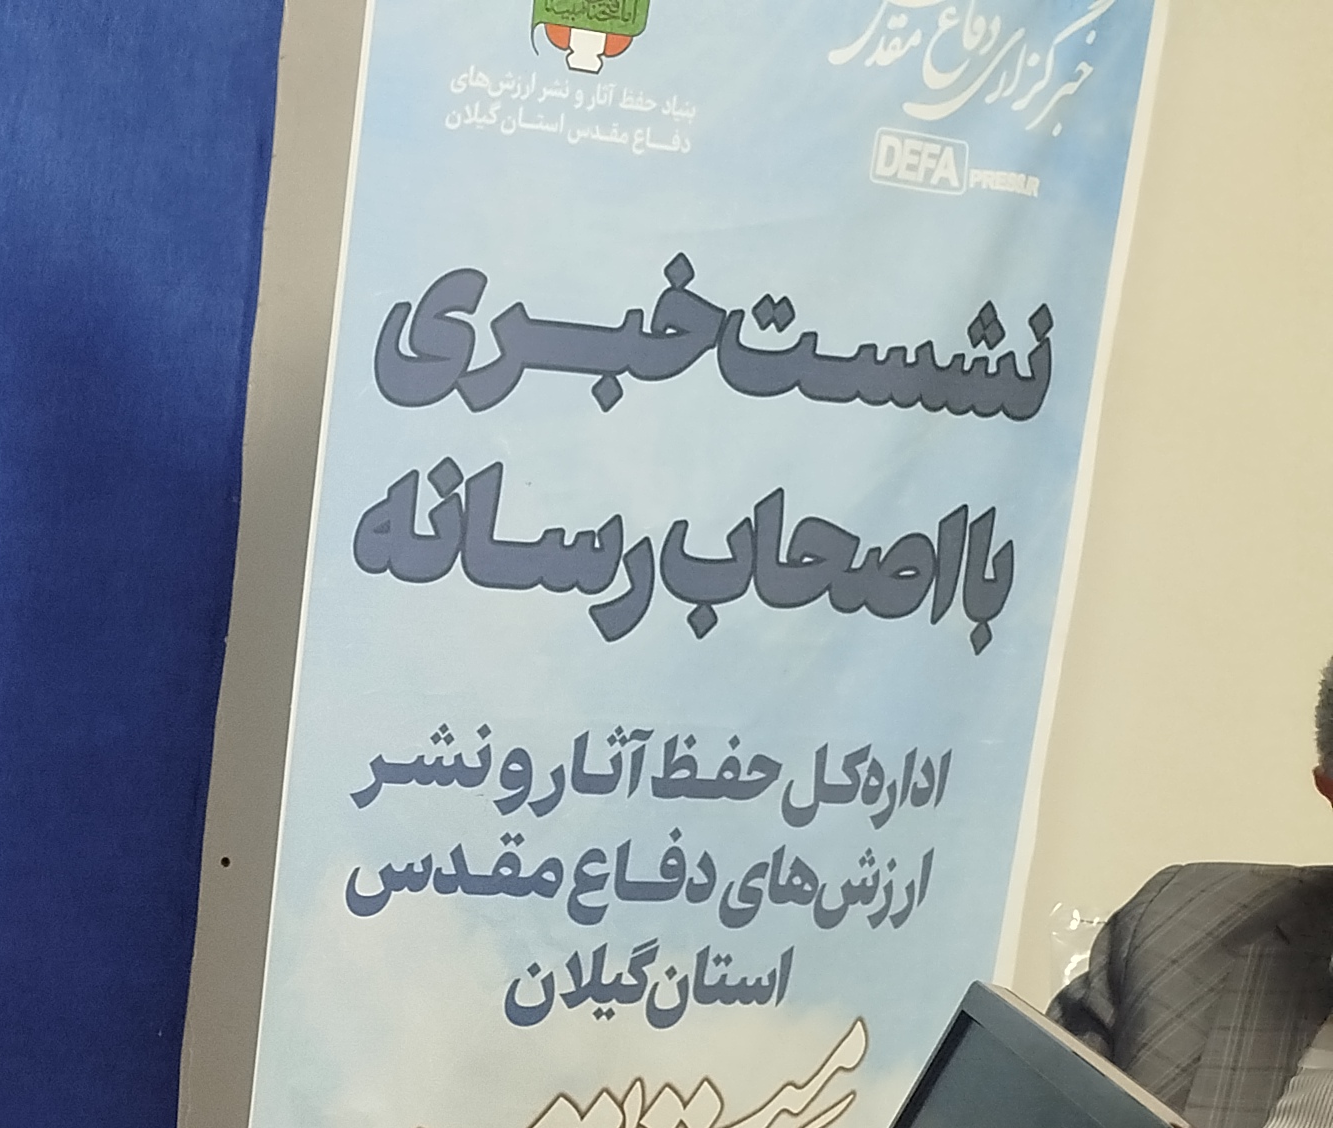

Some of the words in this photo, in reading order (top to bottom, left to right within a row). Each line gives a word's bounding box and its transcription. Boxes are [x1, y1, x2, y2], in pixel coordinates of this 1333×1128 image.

[444, 100, 501, 130] گیلان
[500, 106, 564, 136] استان
[537, 78, 569, 104] نشر
[573, 92, 584, 109] و
[586, 82, 616, 112] آثار
[619, 84, 658, 112] حفظ
[661, 95, 697, 125] بنیاد
[566, 122, 629, 145] مقدس
[631, 128, 692, 156] دفاع
[875, 133, 960, 189] DEFA
[373, 251, 727, 413] خبری
[717, 293, 1055, 423] نشست
[352, 456, 655, 643] رسانه
[660, 486, 970, 640] اصحاب
[966, 505, 1015, 656] با
[349, 721, 495, 808] نشر
[495, 745, 535, 816] و
[527, 724, 653, 818] آثار
[650, 733, 785, 803] حفظ
[344, 830, 565, 918] مقدس
[566, 827, 719, 926] دفاع
[503, 938, 659, 1028] گیلان
[644, 944, 796, 1031] استان
